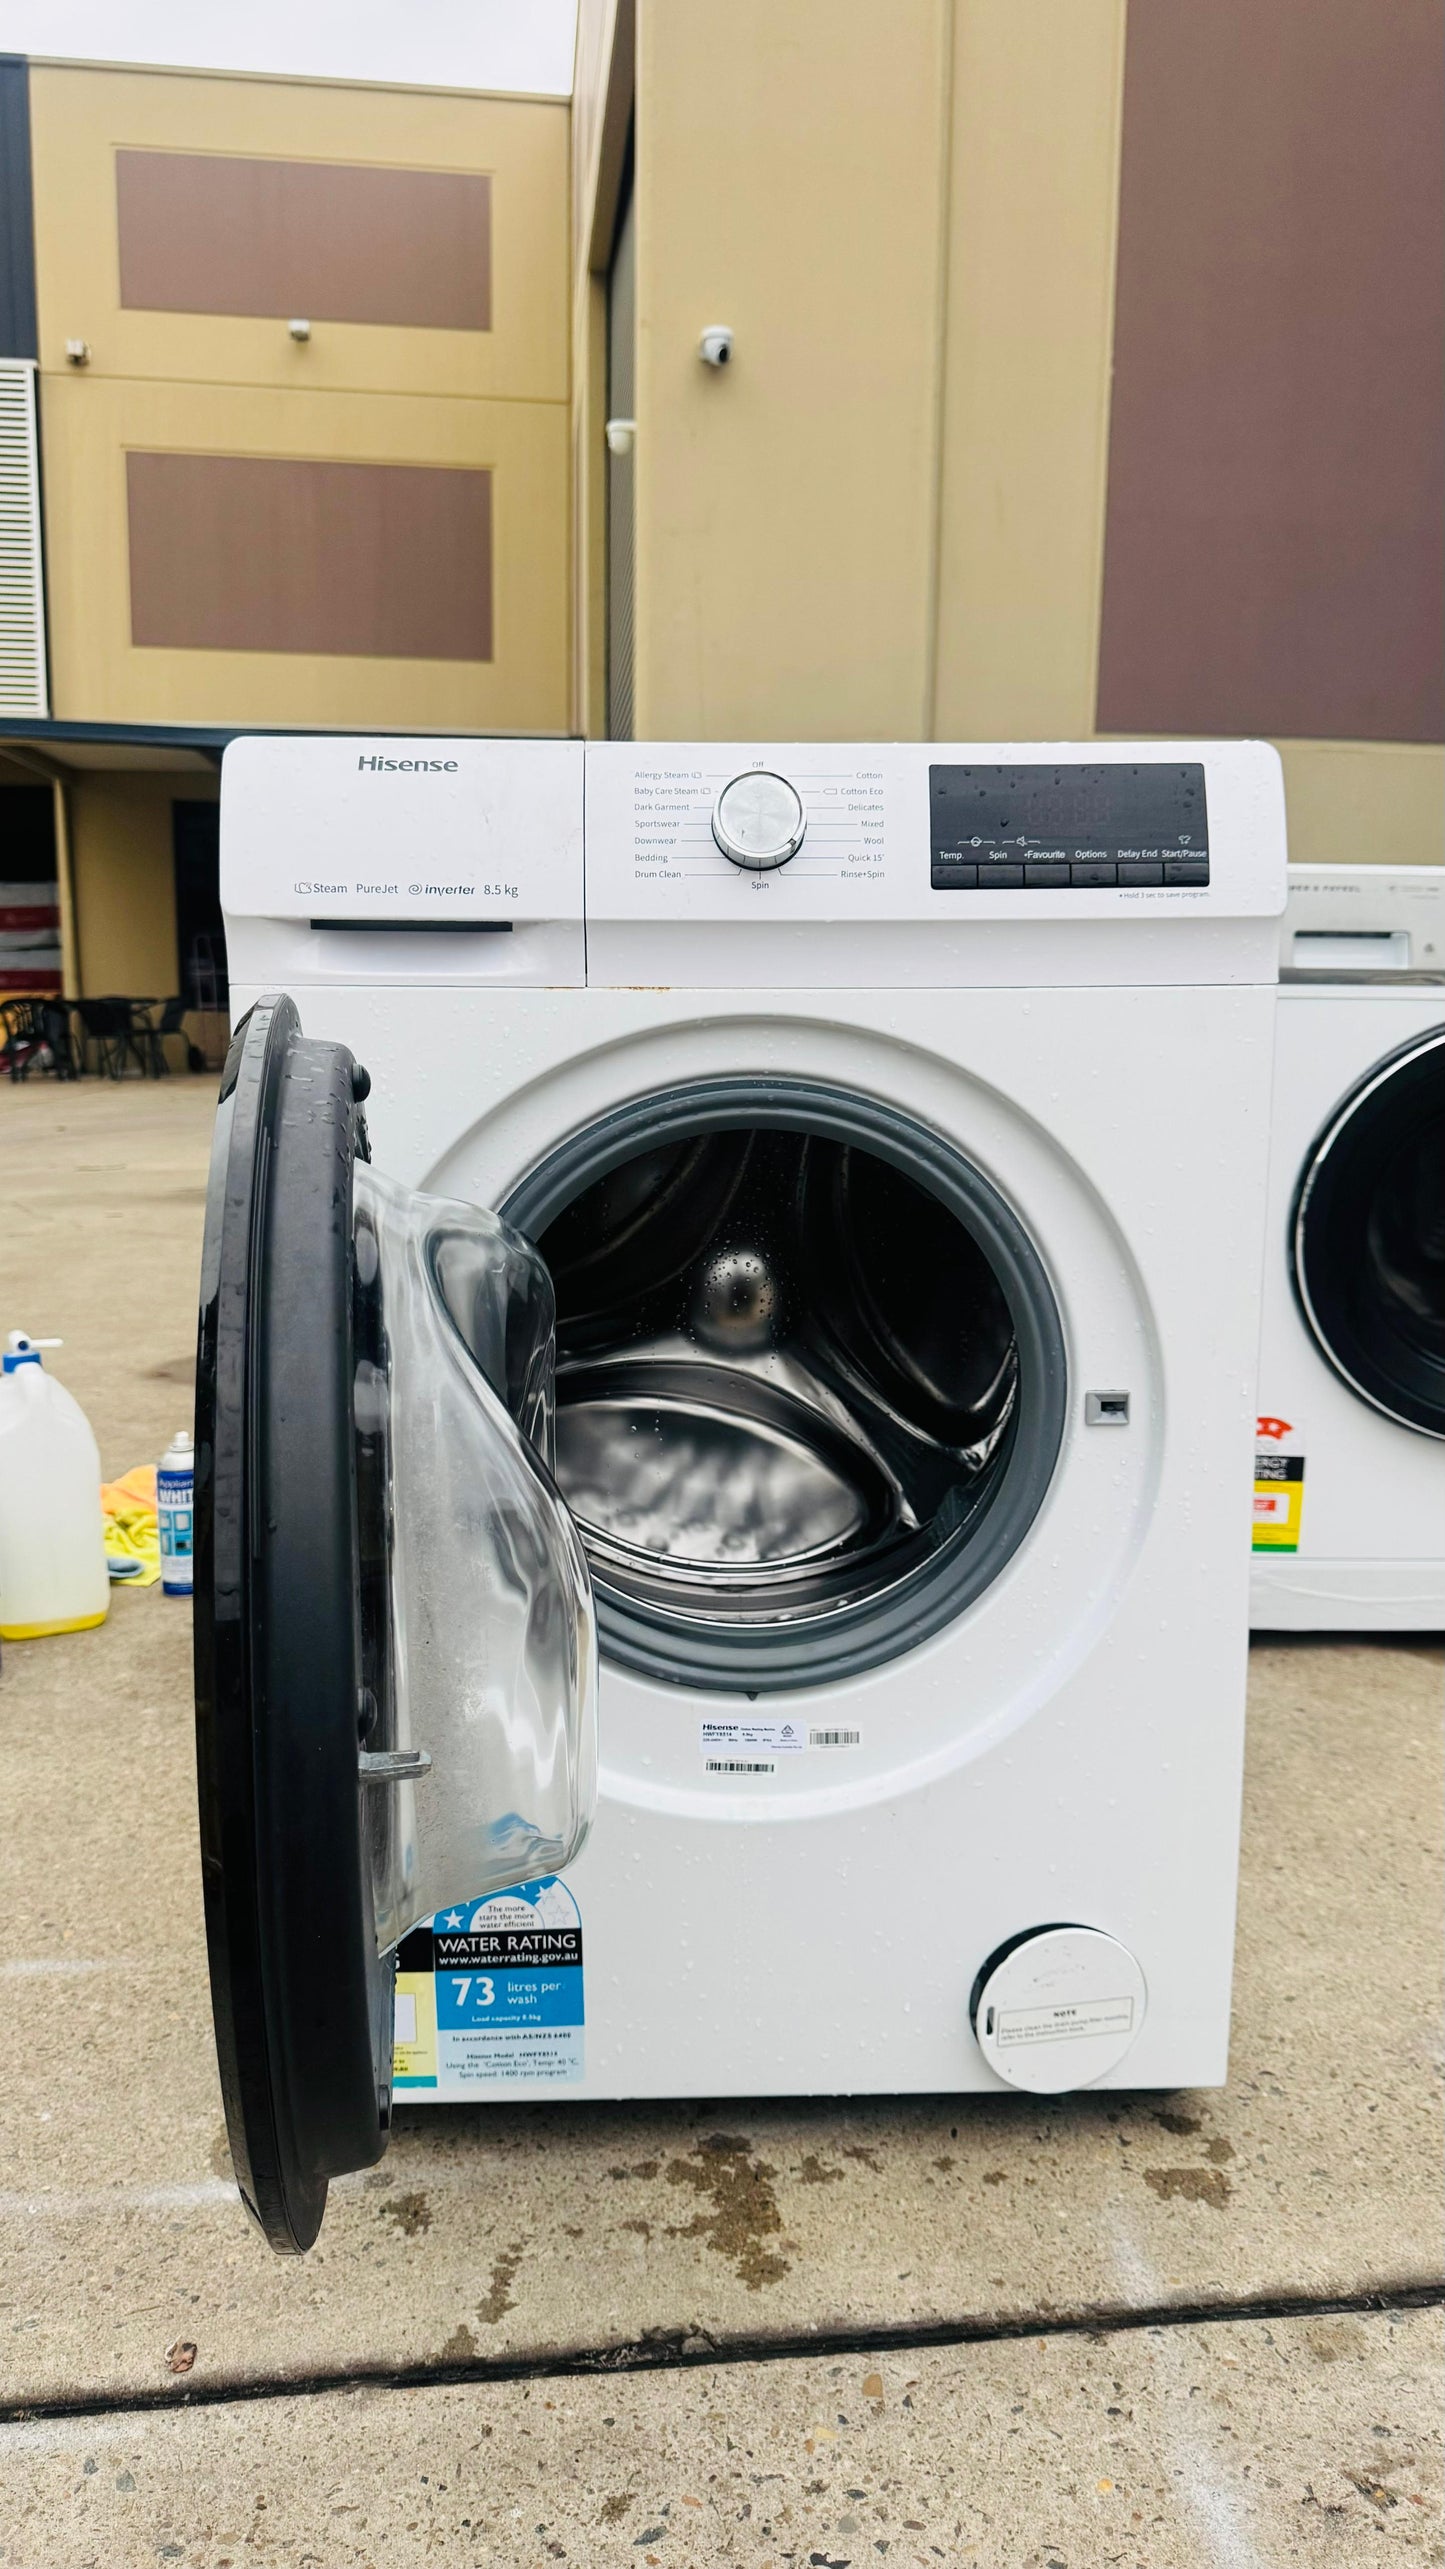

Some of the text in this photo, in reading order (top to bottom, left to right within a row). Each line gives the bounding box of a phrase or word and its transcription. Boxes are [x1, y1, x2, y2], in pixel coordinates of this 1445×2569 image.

[358, 756, 459, 772] Hisense
[634, 772, 662, 780] Allergy
[856, 772, 883, 780] Cotton
[634, 787, 698, 796] Baby Care Steam
[634, 820, 680, 829] Sportswear
[861, 820, 884, 828] Mixed
[634, 837, 677, 845] Downwear
[864, 837, 884, 845] Wool
[634, 854, 668, 863] Bedding
[848, 854, 871, 862] Quick
[939, 851, 964, 860] Temp.
[989, 850, 1008, 860] Spin
[1075, 850, 1107, 860] Options
[1118, 850, 1157, 860] Delay End
[1162, 849, 1207, 859] Start/Pause
[634, 870, 682, 878] Drum Clean
[840, 870, 885, 879] Rinse+Spin
[314, 882, 400, 894] Steam PureJet
[424, 883, 476, 896] inverter
[751, 881, 769, 890] Spin
[484, 884, 519, 898] 8.5 kg
[488, 1905, 502, 1913] The
[504, 1920, 534, 1928] efficient
[438, 1934, 576, 1952] WATER RATING
[439, 1952, 578, 1965] www.waterrating.gov.au
[452, 1976, 495, 2006] 73
[507, 1981, 561, 1995] litres per
[507, 1995, 537, 2005] wash
[1053, 2008, 1077, 2017] NOTE
[491, 2015, 520, 2023] capacity
[462, 2034, 502, 2042] accordance
[537, 2069, 568, 2077] program
